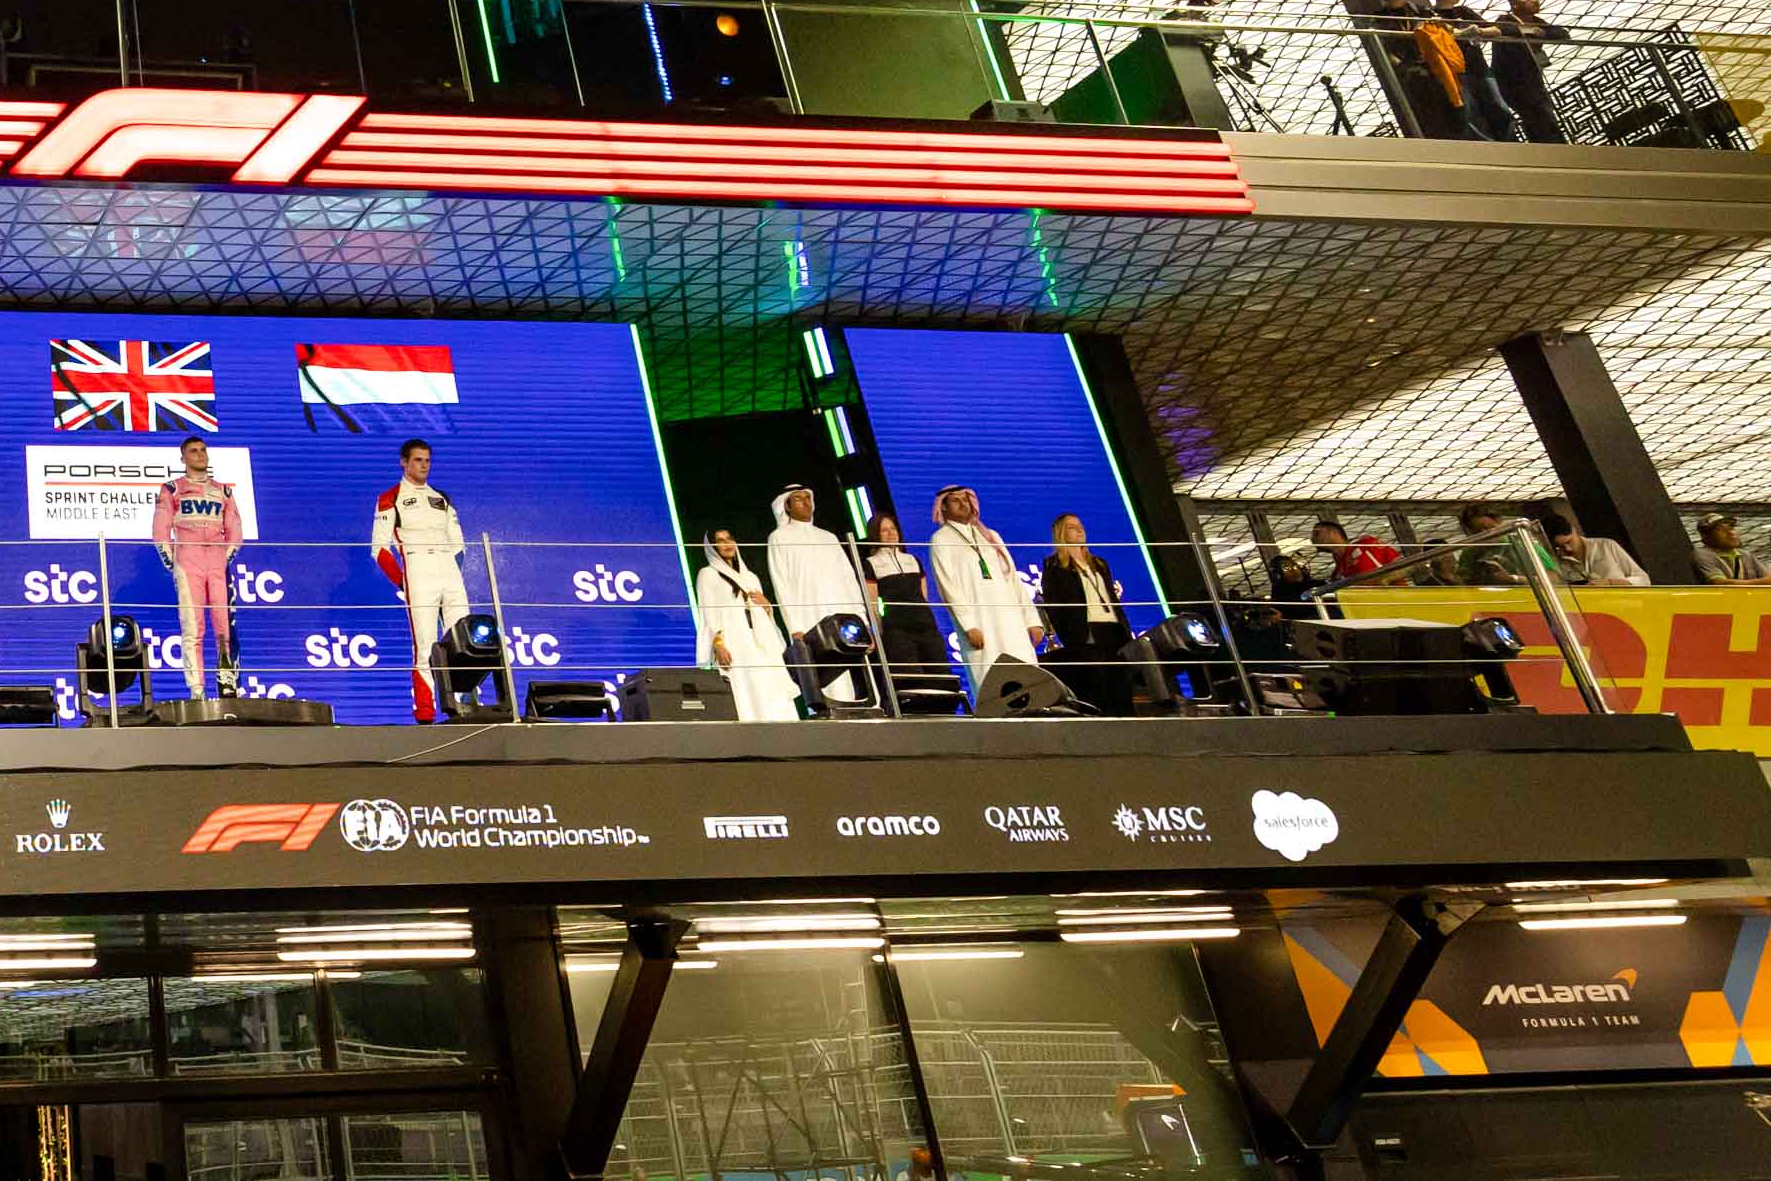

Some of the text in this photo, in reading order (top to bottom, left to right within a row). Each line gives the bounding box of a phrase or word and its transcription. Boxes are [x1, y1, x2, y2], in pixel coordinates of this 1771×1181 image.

[8, 87, 369, 186] F1
[44, 491, 95, 505] SPRINT
[180, 499, 223, 516] BWT
[46, 506, 138, 520] MIDDLE EAST
[23, 563, 98, 604] stc
[233, 563, 285, 604] tc
[572, 563, 644, 603] stc
[142, 627, 184, 669] tc
[305, 627, 379, 667] stc
[1471, 610, 1771, 726] DH
[345, 808, 406, 841] FIA
[410, 804, 557, 825] FIA Formula 1
[836, 815, 941, 837] aramco
[984, 805, 1064, 832] QATAR
[1141, 805, 1207, 831] MSC
[1264, 814, 1330, 833] salesforce
[180, 802, 341, 854] F1
[414, 827, 482, 849] World
[703, 815, 789, 838] PIRELLI
[1009, 827, 1070, 843] AIRWAYS
[16, 833, 105, 853] ROLEX
[1482, 983, 1631, 1006] McLaren
[1522, 1016, 1586, 1028] FORMULA
[1603, 1014, 1641, 1026] TEAM
